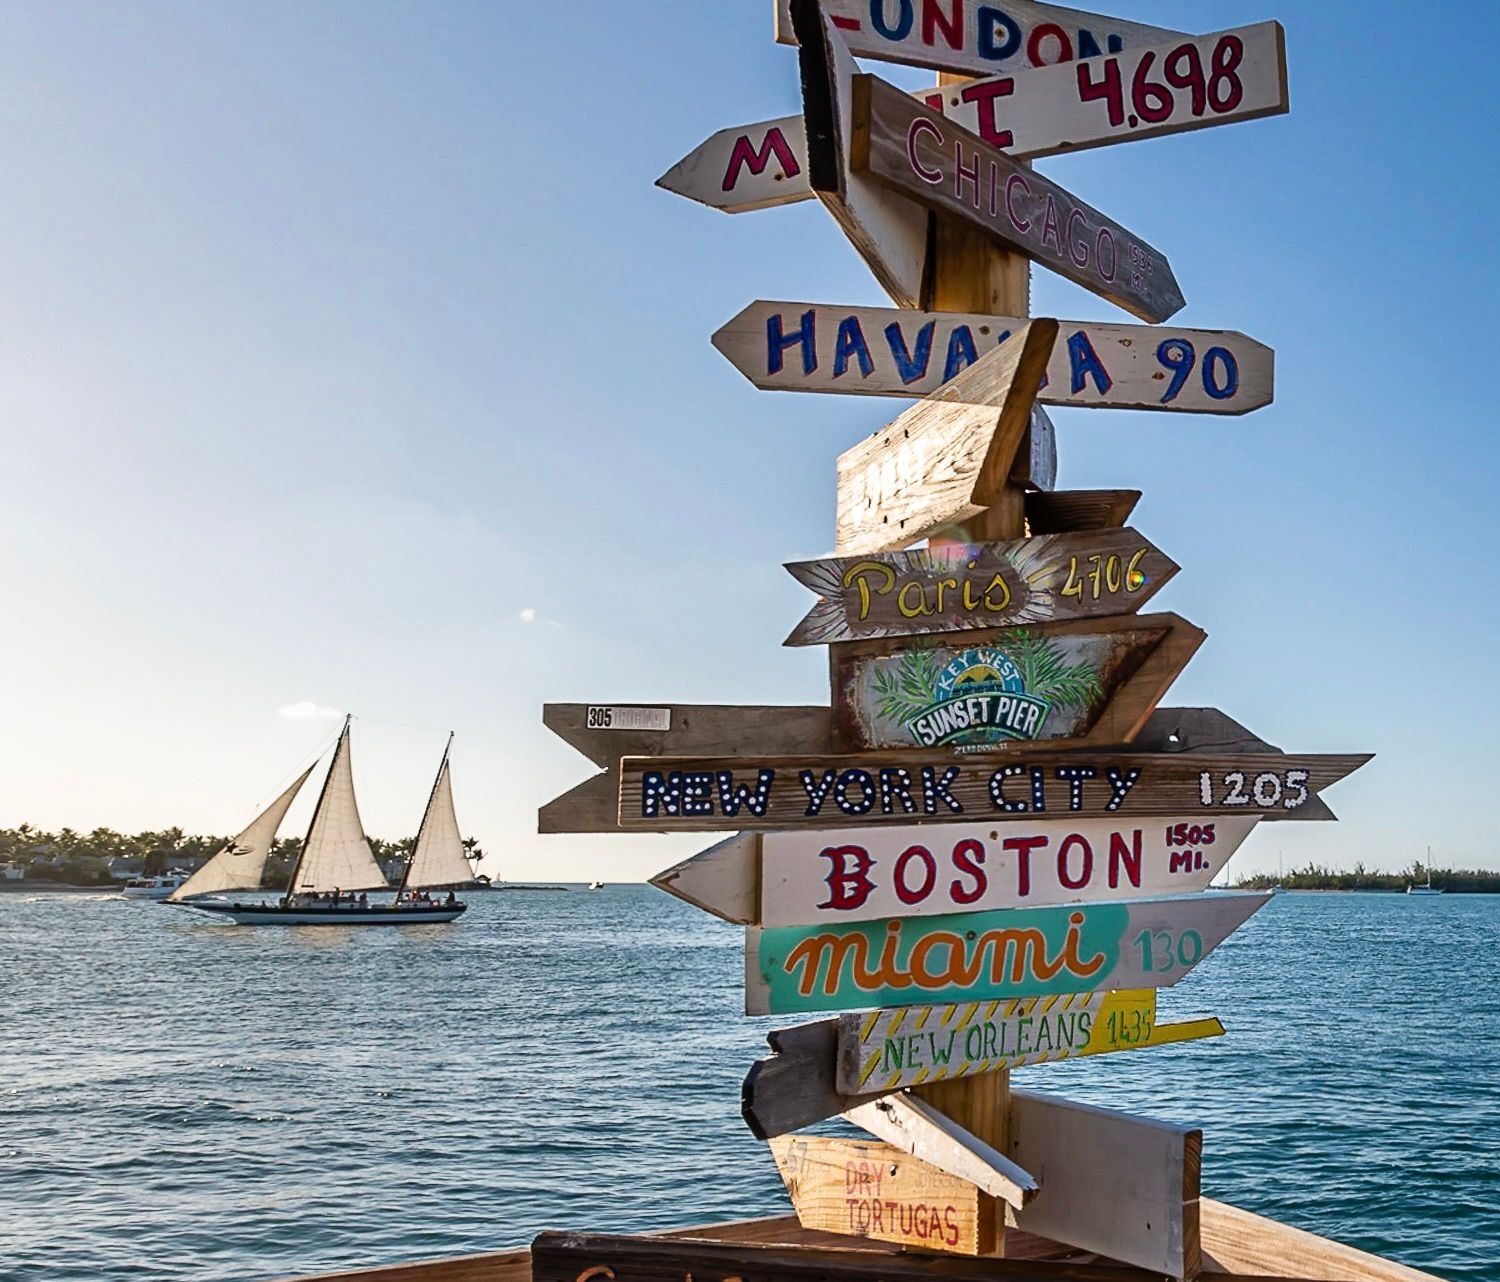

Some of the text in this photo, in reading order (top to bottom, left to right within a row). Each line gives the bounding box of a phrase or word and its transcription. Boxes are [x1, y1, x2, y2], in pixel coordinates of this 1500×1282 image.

[832, 0, 1123, 68] ONDON
[907, 117, 1116, 283] CHICAGO
[766, 309, 1239, 404] HAVAA 90
[843, 548, 1148, 621] Paris 4706
[938, 649, 1020, 691] KEY WEST
[589, 707, 612, 727] 305
[917, 697, 1040, 747] SUNSET PIER
[643, 764, 1310, 817] NEW YORK CITY 1205
[1165, 823, 1216, 847] 1505
[817, 829, 1143, 910] BOSTON
[1169, 851, 1210, 873] MI.
[784, 912, 1206, 996] miami 130
[881, 1009, 1151, 1074] NEW ORLEANS 1435
[845, 1160, 885, 1196] DRY
[845, 1199, 960, 1247] TORTUGAS
